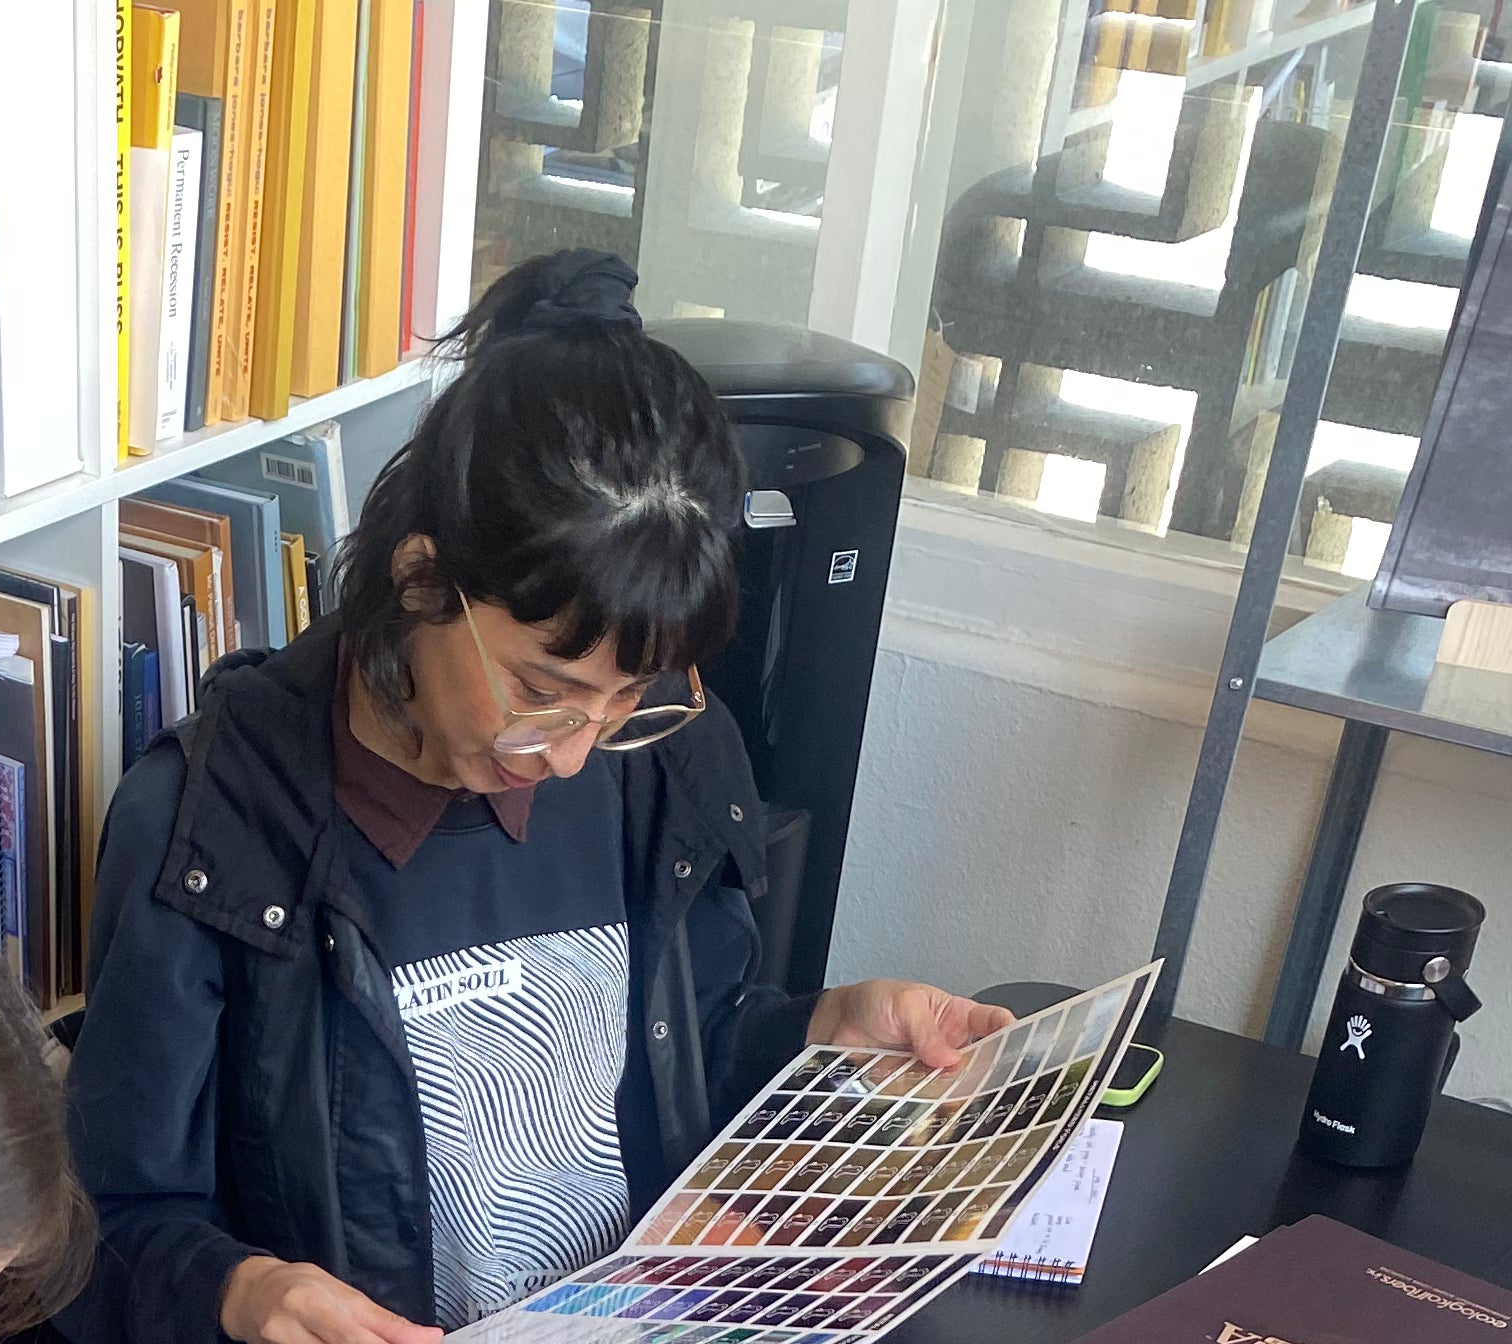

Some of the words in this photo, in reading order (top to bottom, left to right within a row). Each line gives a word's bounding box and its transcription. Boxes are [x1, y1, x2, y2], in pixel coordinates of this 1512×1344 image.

[172, 150, 189, 237] Permanent
[168, 242, 182, 318] Recession
[457, 968, 510, 995] SOUL
[1313, 1109, 1332, 1129] Hydro
[1332, 1120, 1356, 1135] Flask
